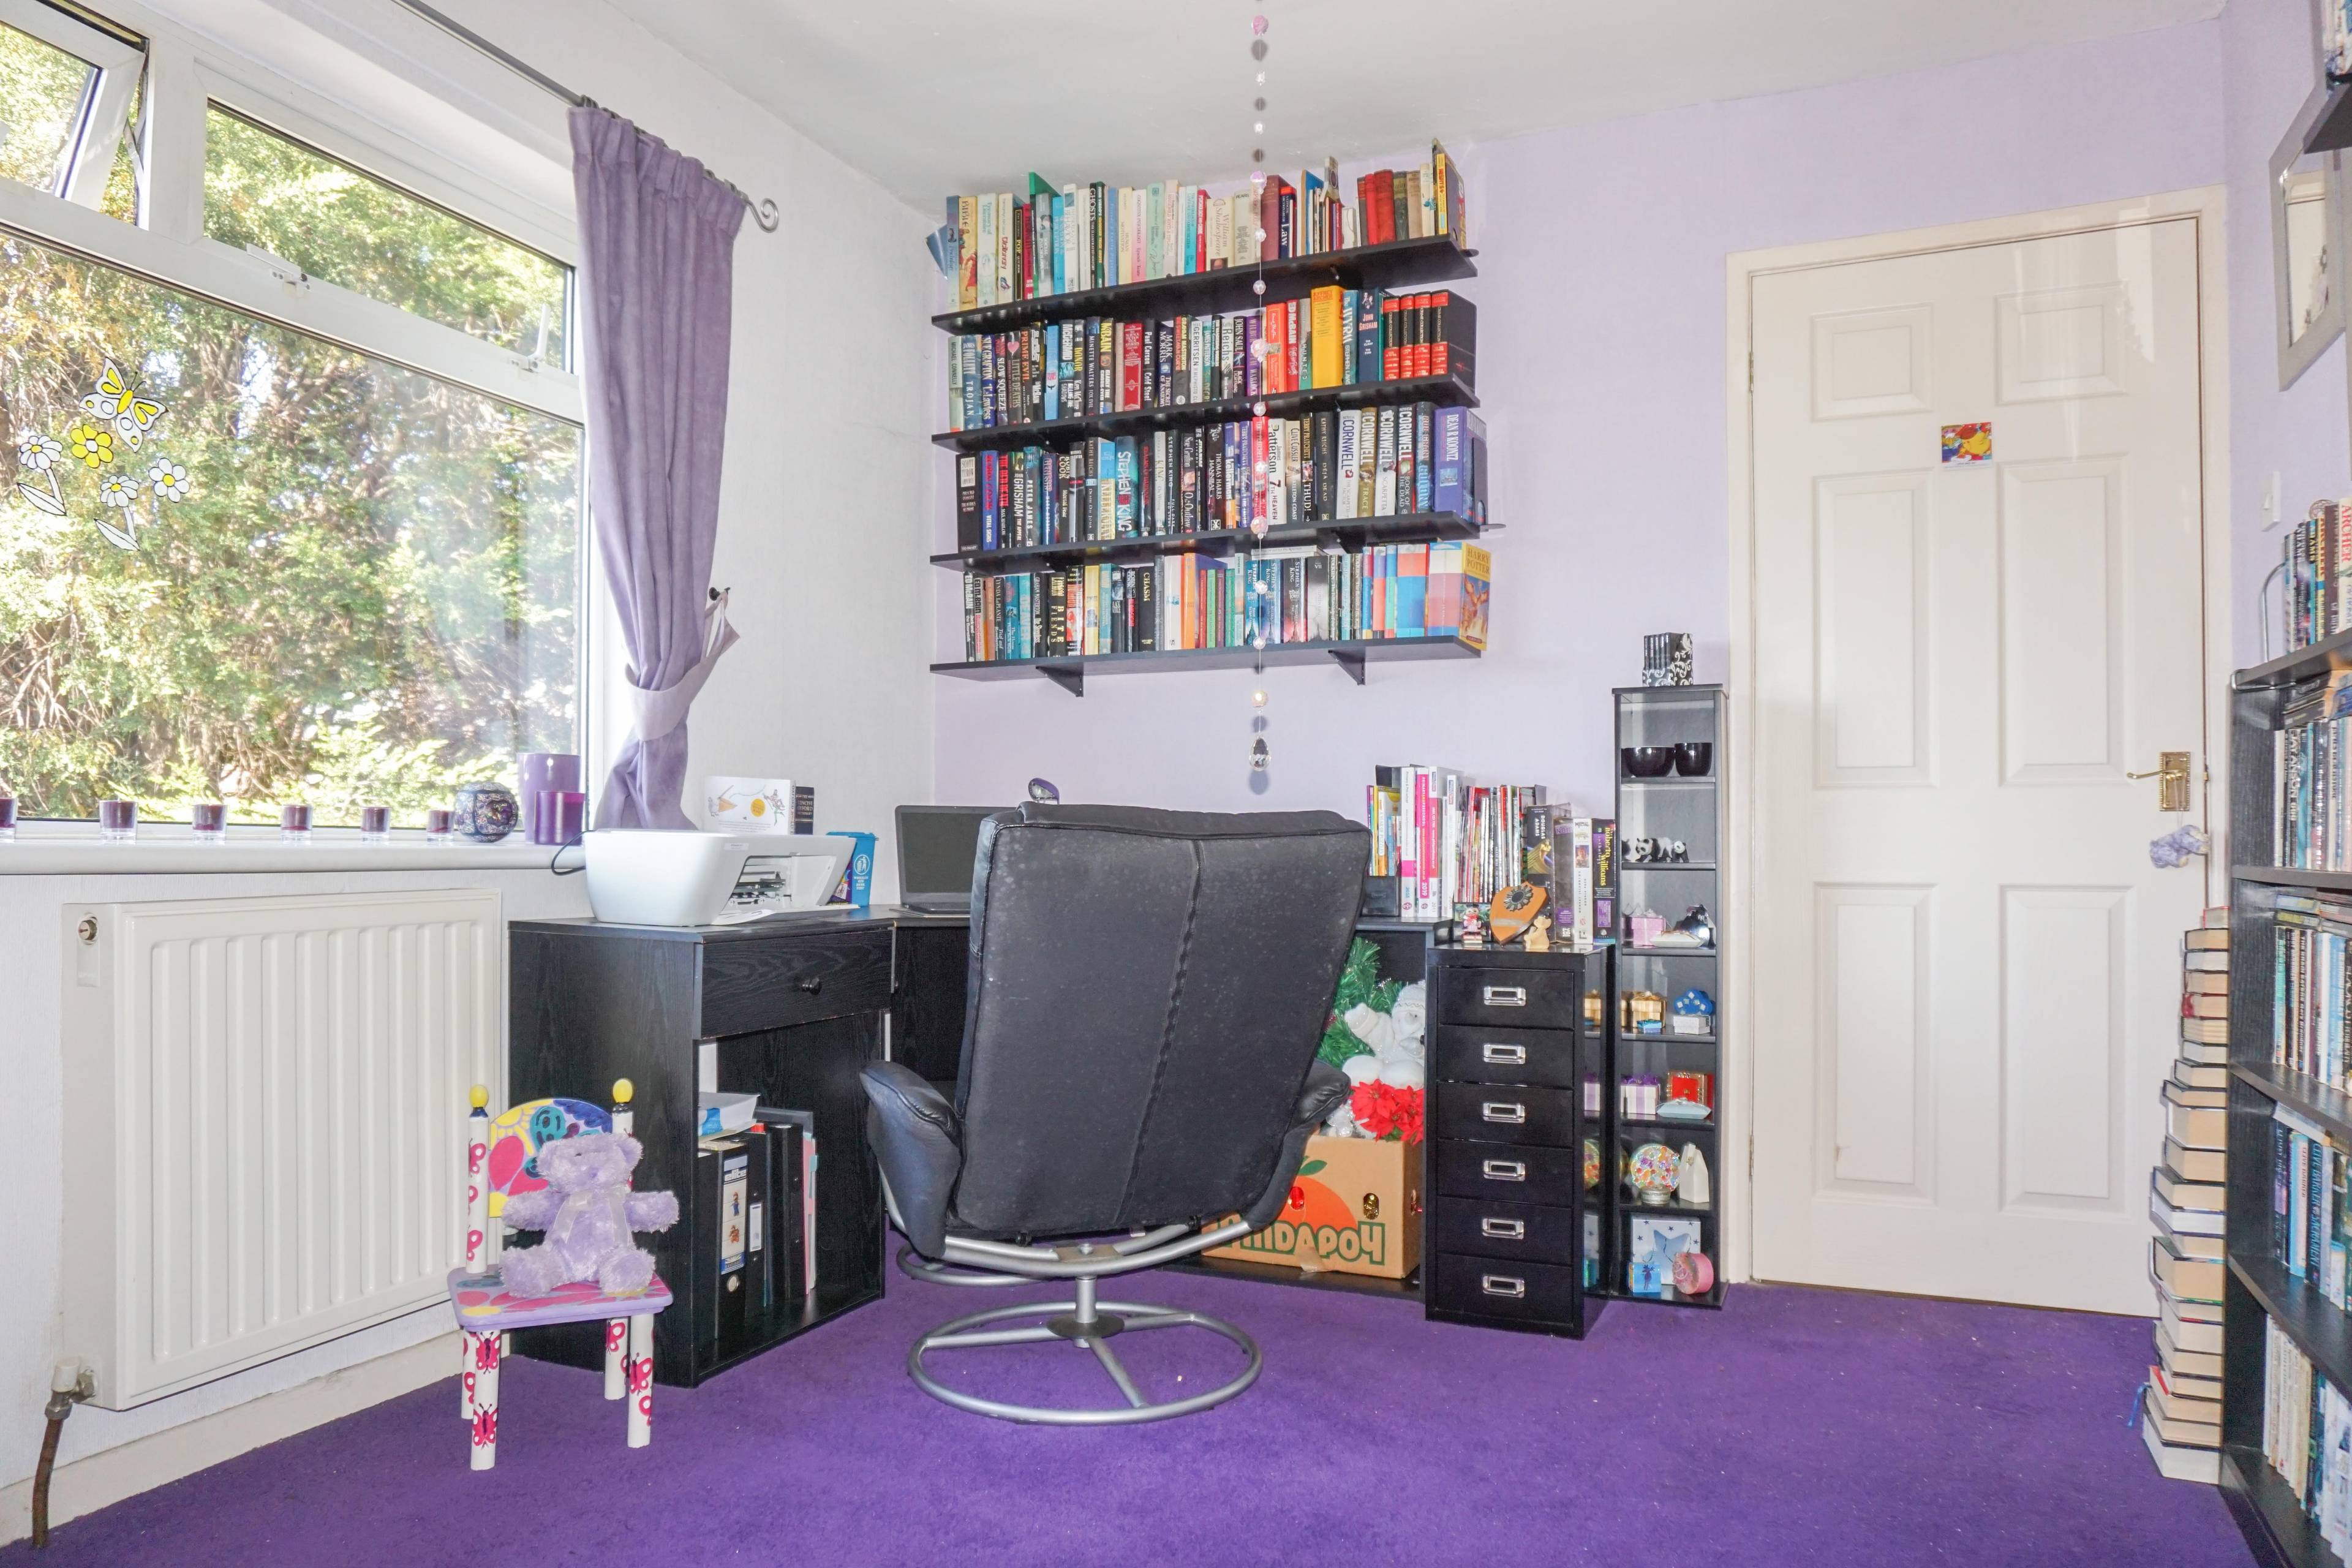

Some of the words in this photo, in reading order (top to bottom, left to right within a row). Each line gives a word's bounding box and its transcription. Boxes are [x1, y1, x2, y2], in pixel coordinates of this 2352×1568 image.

[1213, 208, 1223, 255] Shakespeare
[1343, 307, 1352, 344] WYRM
[1359, 322, 1378, 331] GRISHAM
[963, 349, 975, 374] FOLLETT
[1223, 329, 1232, 361] Reichs
[982, 350, 992, 380] GRAFTON
[965, 381, 974, 415] TROJAN
[1399, 412, 1412, 461] CORNWELL
[1447, 414, 1458, 431] DEAN
[1341, 420, 1354, 470] CORNWELL
[1360, 416, 1375, 465] CORNWELL
[1379, 417, 1394, 464] CORNWELL
[1446, 437, 1458, 461] KOONTZ
[1117, 451, 1131, 494] STEPHEN
[1014, 478, 1023, 516] GRISHAM
[1405, 497, 1409, 506] OF
[1117, 504, 1132, 532] KING
[1185, 503, 1193, 527] Outlaw
[2342, 505, 2351, 562] ARCHER
[1468, 549, 1489, 564] HARRY
[1468, 559, 1490, 574] POTTER
[2310, 1214, 2320, 1267] SACRAMENT
